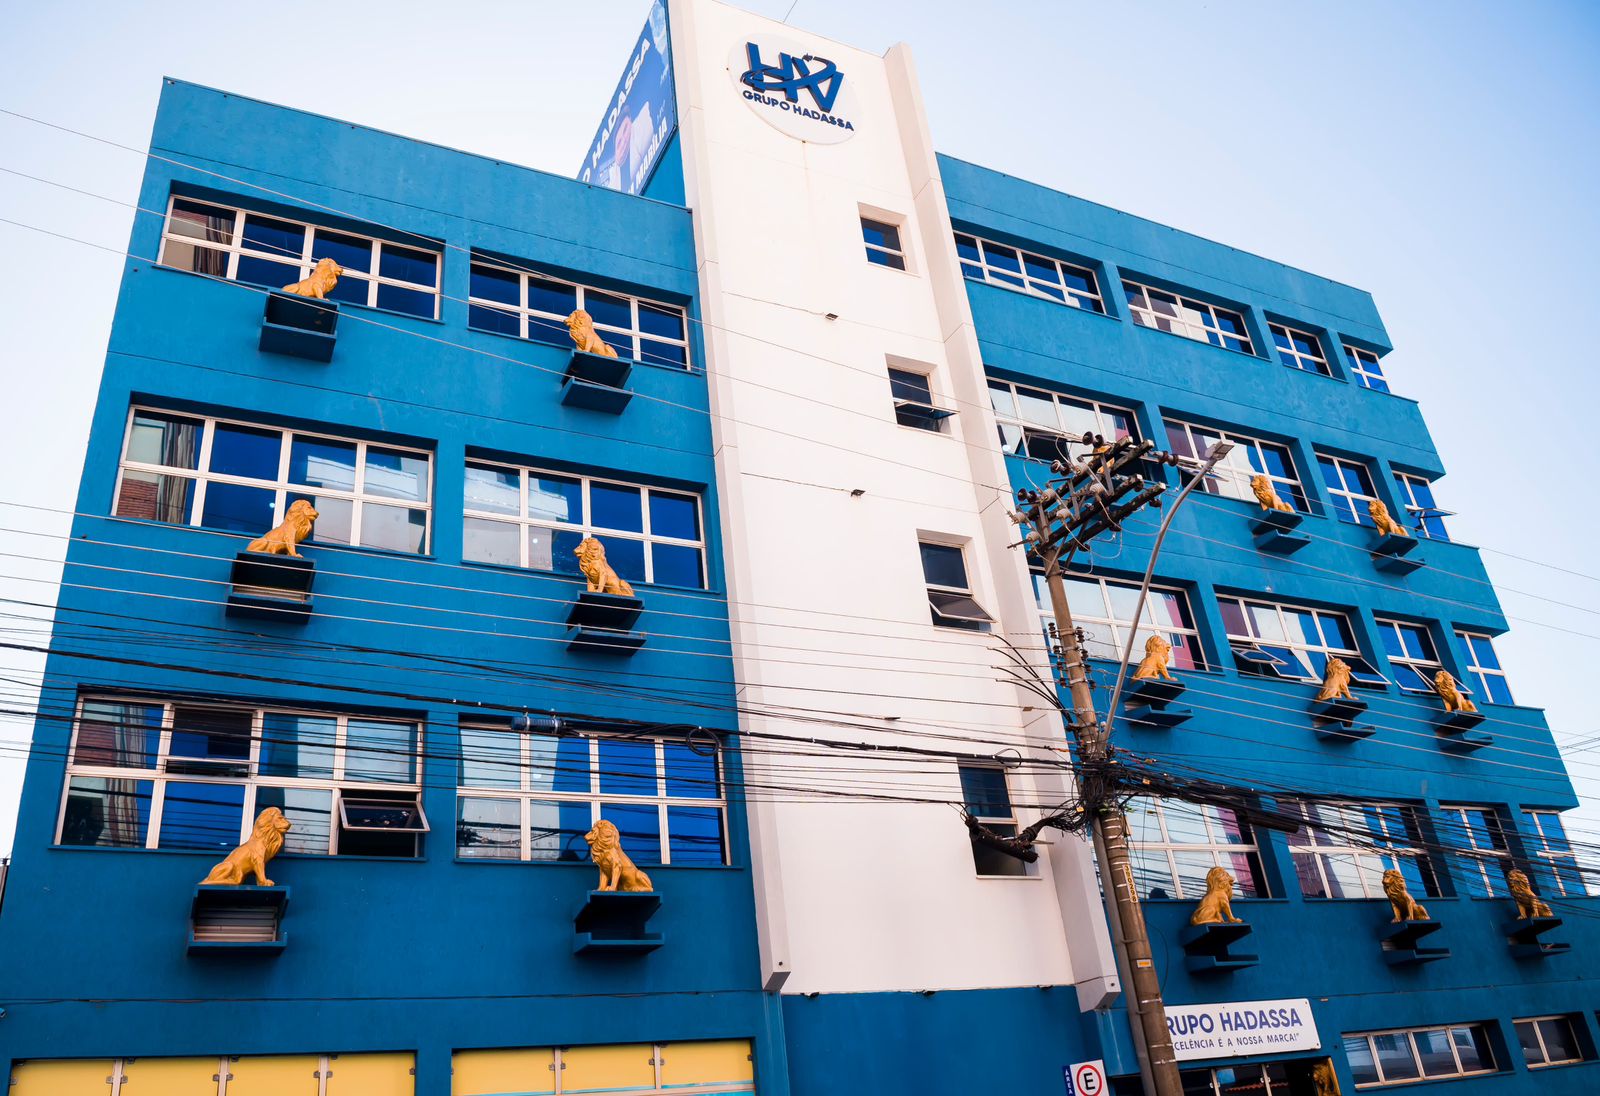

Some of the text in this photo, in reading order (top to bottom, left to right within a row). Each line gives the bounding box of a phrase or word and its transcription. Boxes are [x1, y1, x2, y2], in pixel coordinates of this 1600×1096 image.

[592, 38, 650, 169] HADASSA
[742, 89, 855, 131] GRUPO HADASSA
[1166, 1008, 1303, 1036] RUPO HADASSA
[1174, 1038, 1215, 1051] CELÊNCIA
[1227, 1038, 1234, 1047] A
[1236, 1035, 1264, 1046] NOSSA
[1083, 1072, 1096, 1091] E
